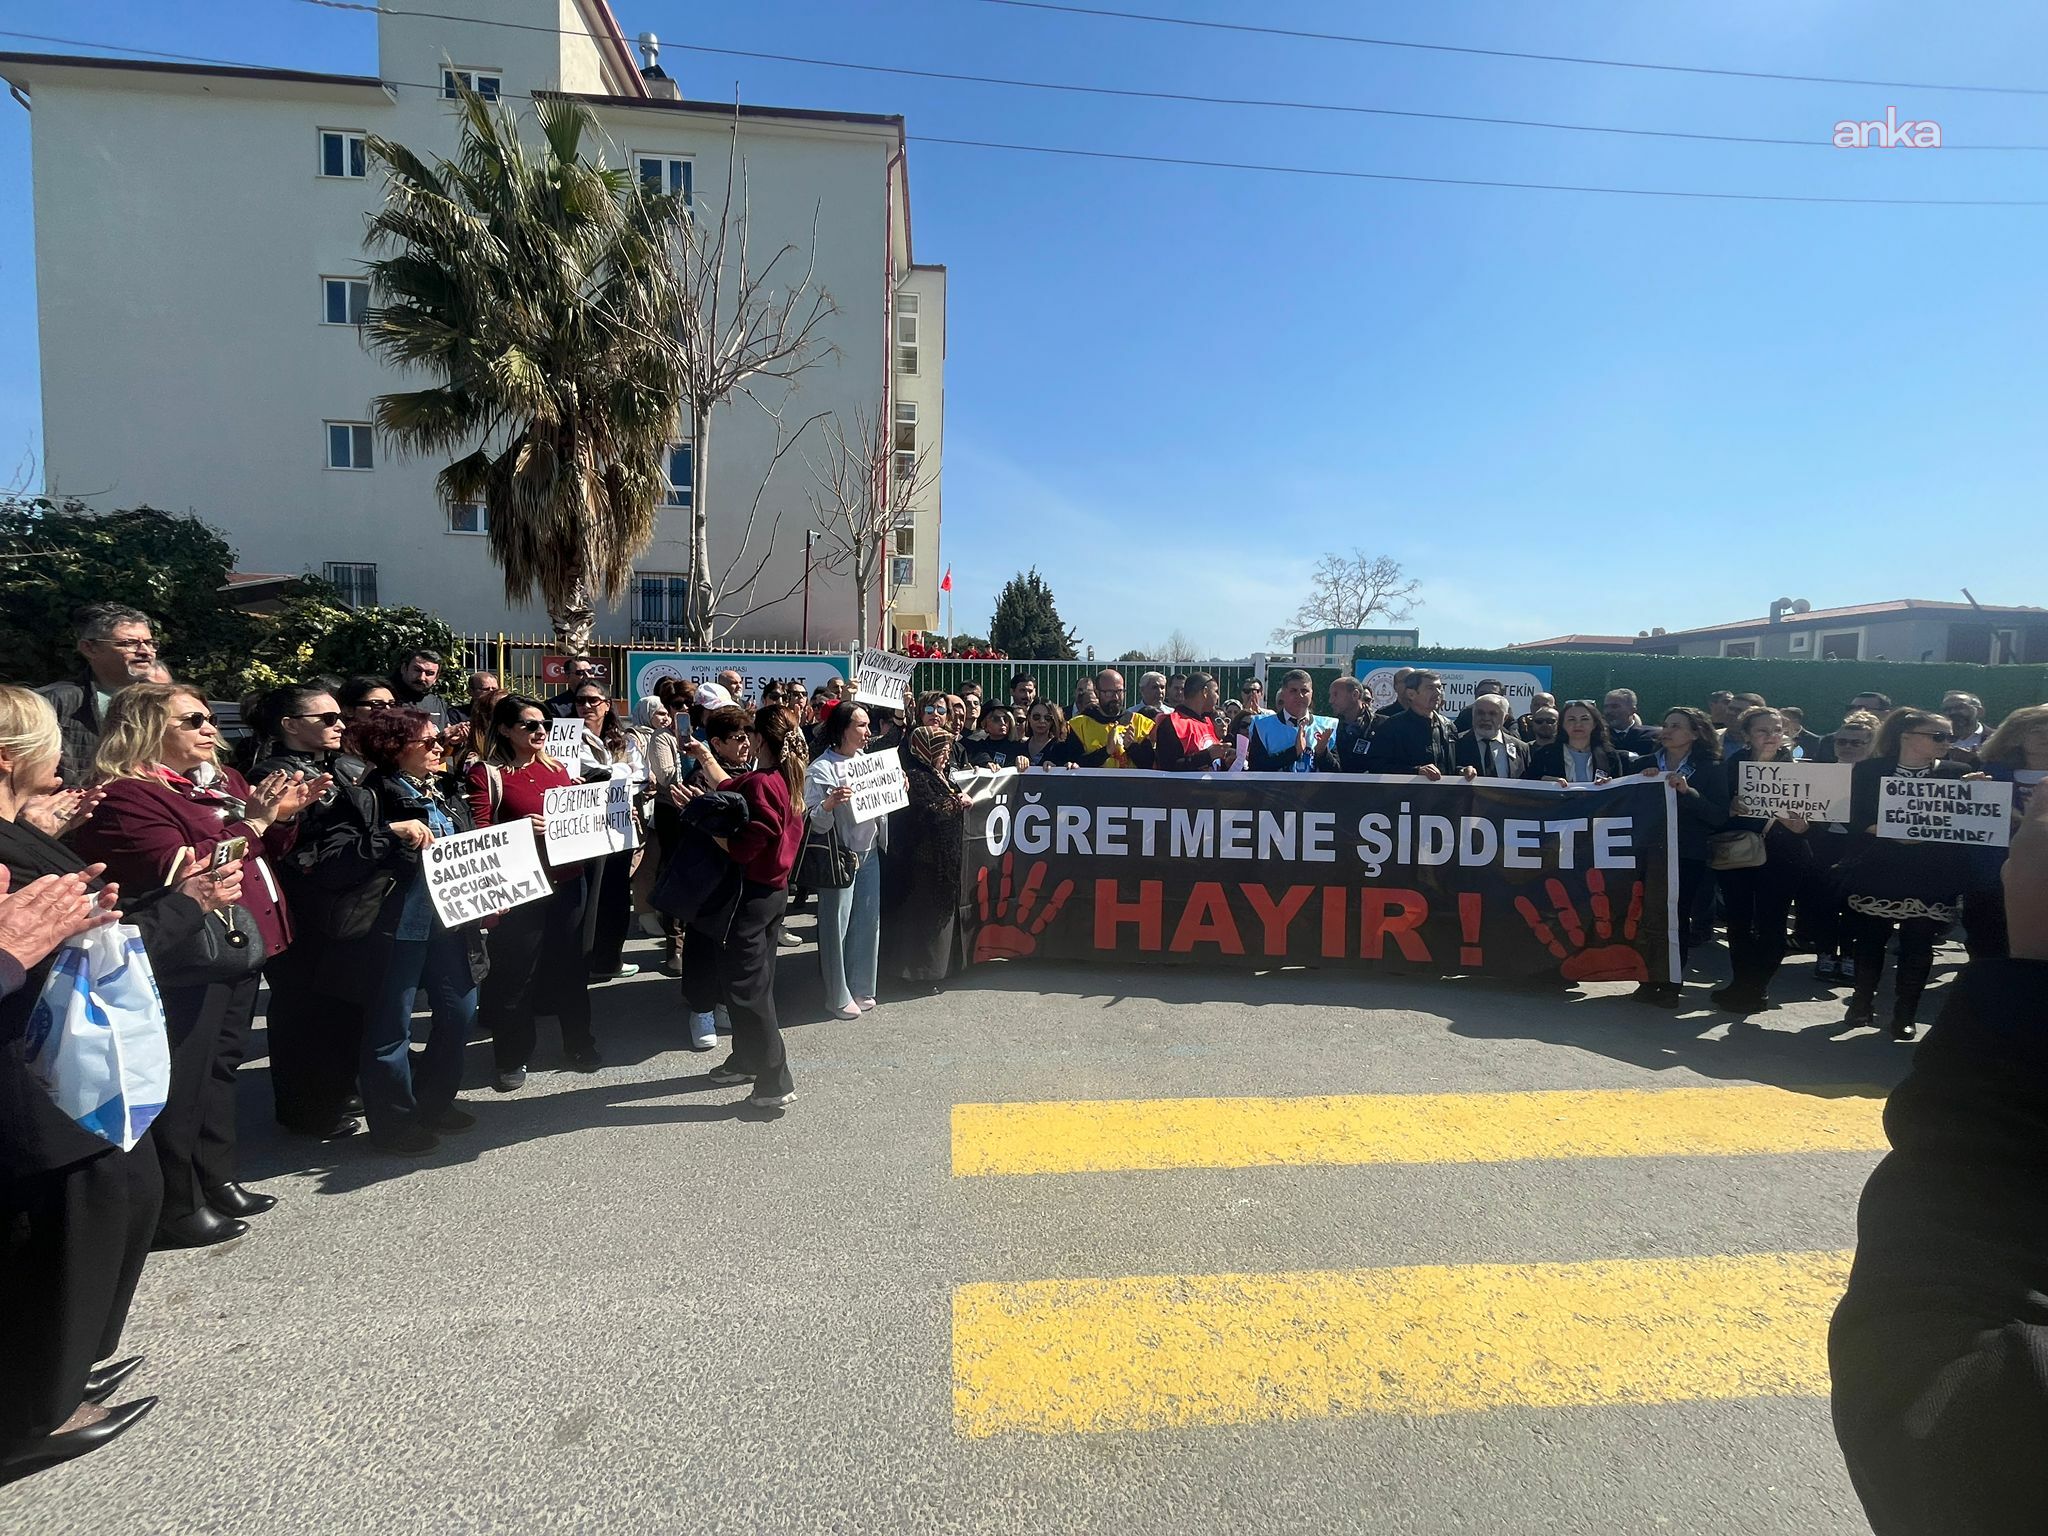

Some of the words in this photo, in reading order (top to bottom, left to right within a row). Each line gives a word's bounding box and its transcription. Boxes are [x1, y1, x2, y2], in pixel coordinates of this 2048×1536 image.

[432, 831, 509, 863] ÖĞRETMENE
[985, 792, 1336, 862] ÖĞRETMENE
[1356, 801, 1636, 878] ŞİDDETE
[432, 852, 501, 885] SALDIRAN
[443, 900, 469, 922] NE
[1093, 878, 1434, 962] HAYIR
